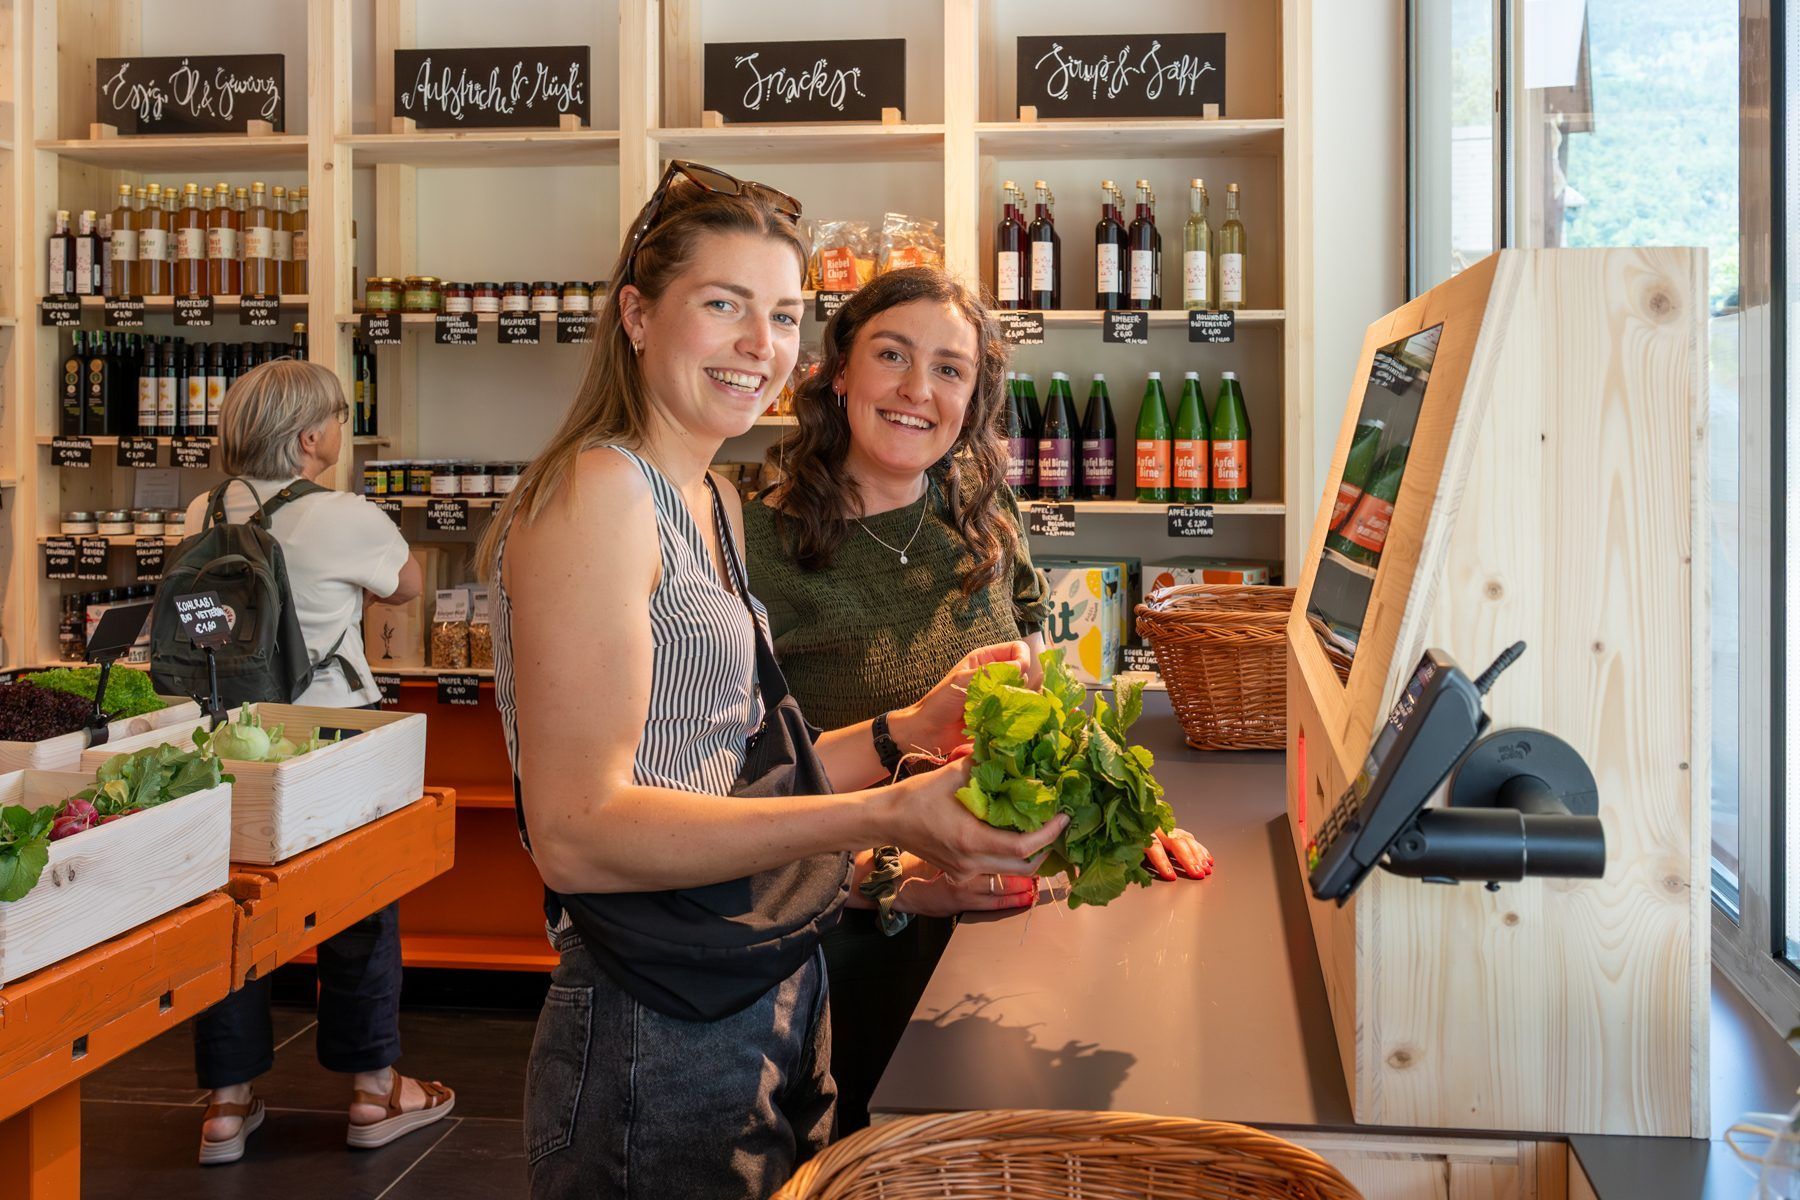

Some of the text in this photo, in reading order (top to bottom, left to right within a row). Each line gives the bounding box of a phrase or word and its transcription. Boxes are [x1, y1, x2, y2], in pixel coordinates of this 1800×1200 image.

[1035, 40, 1216, 100] Sirup & Saft
[735, 53, 865, 110] Snacks
[402, 58, 513, 119] Aufstriche
[511, 61, 529, 105] &
[199, 81, 215, 117] &
[827, 258, 850, 269] Riebel
[827, 270, 848, 280] Chips
[177, 300, 209, 308] MOSTESSIG
[370, 320, 389, 328] HONIG
[500, 318, 536, 326] NASCHKATZE
[1111, 315, 1141, 323] HIMBEER-
[1052, 458, 1069, 467] Birne
[1100, 457, 1114, 467] Birne
[1137, 456, 1155, 467] Apfel
[1175, 456, 1194, 467] Apfel
[1214, 456, 1235, 467] Apfel
[1140, 467, 1159, 478] Birne
[1178, 467, 1198, 478] Birne
[1218, 467, 1239, 478] Birne
[1195, 509, 1214, 517] BIRNE
[176, 597, 214, 612] KOHLRABI
[180, 613, 193, 623] BIO
